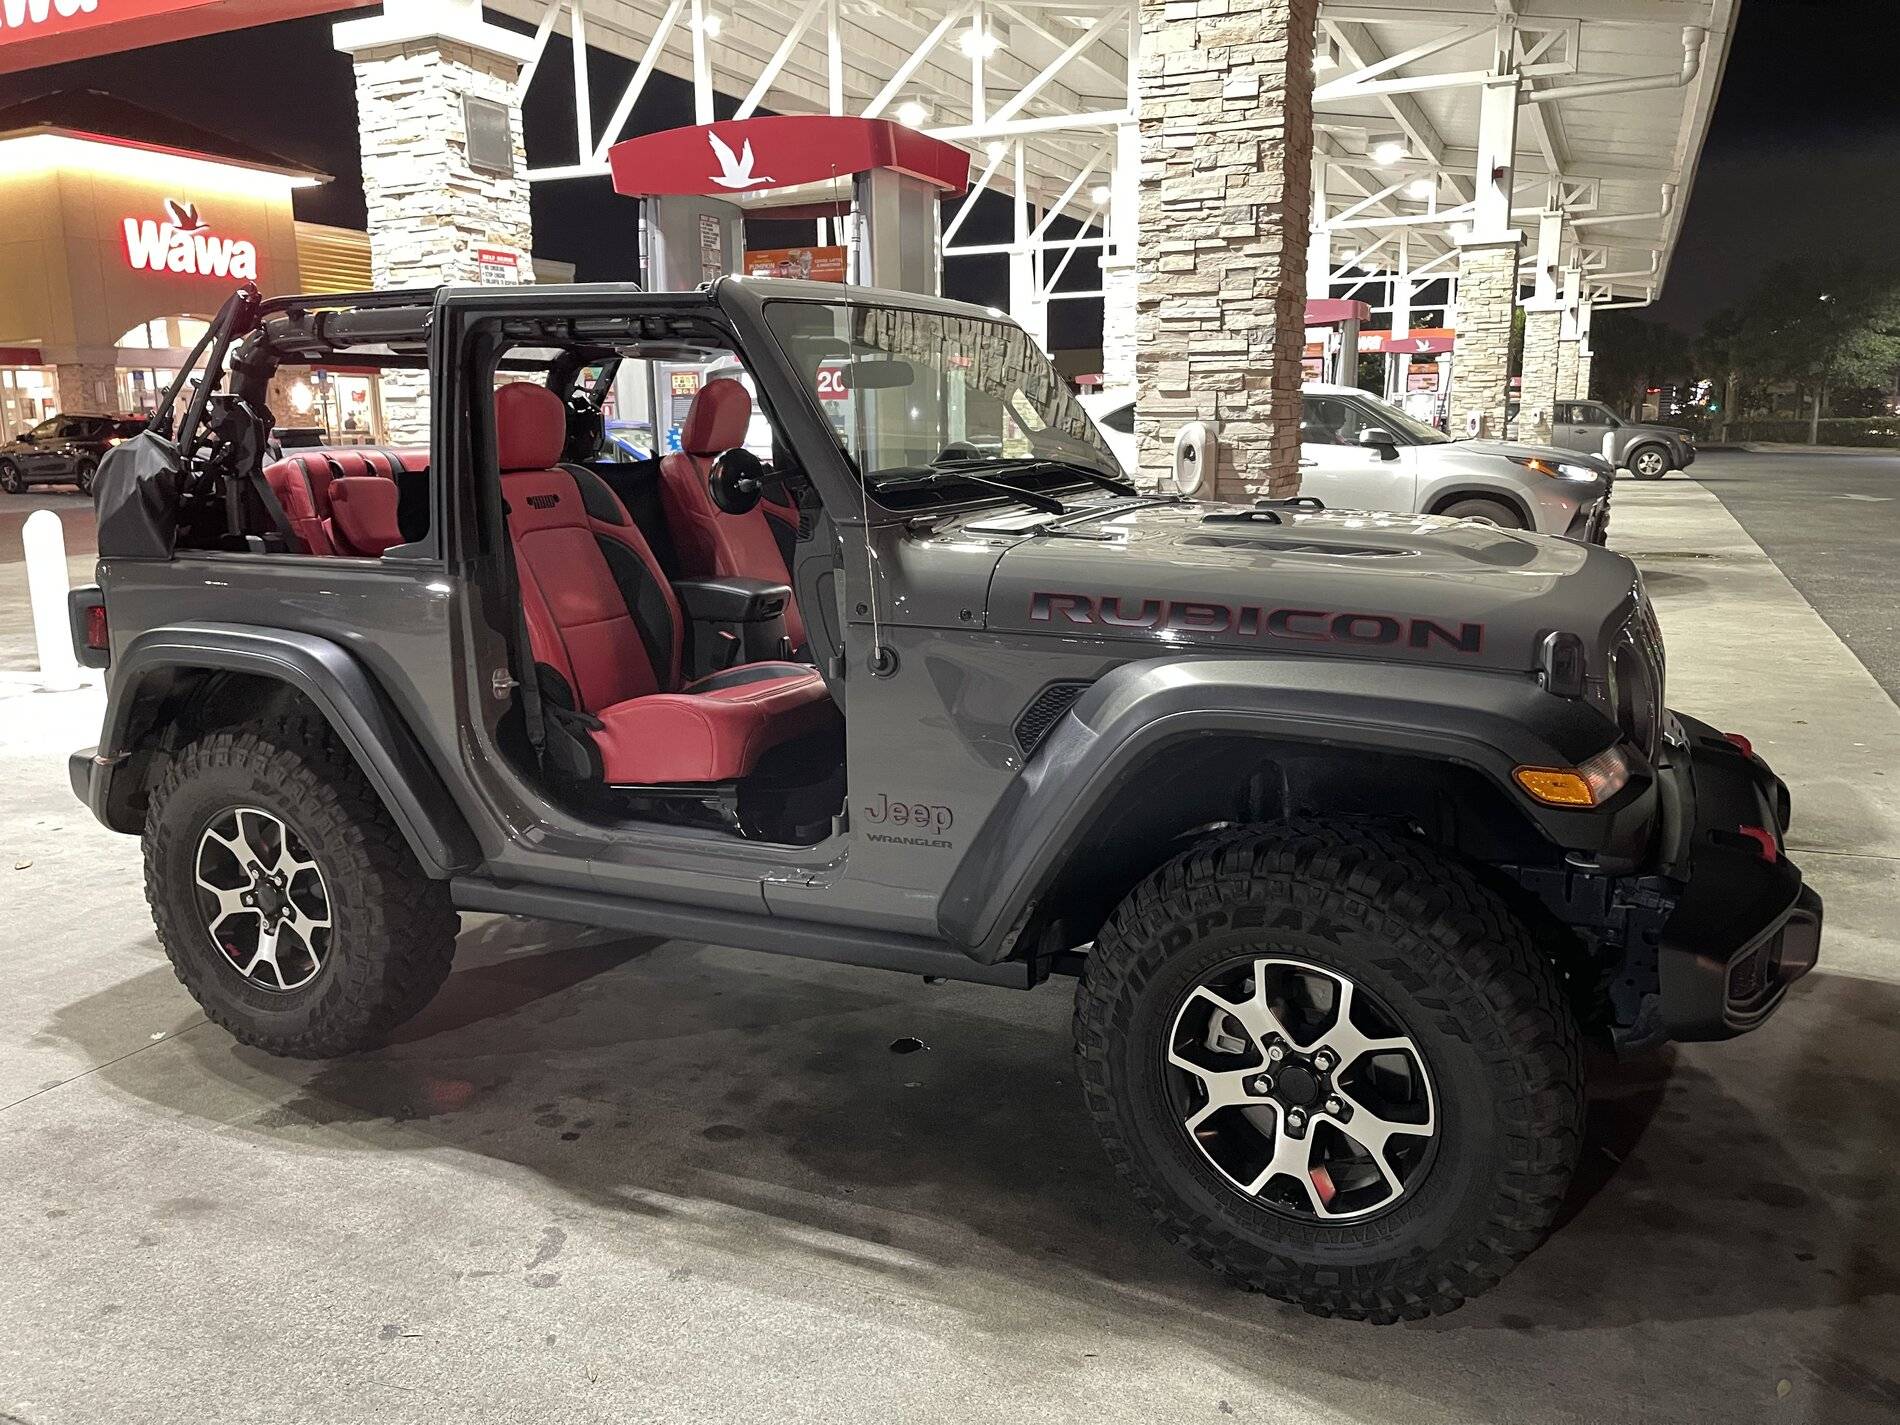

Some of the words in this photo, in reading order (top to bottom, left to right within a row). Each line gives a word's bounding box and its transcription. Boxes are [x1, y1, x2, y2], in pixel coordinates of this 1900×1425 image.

[124, 217, 257, 280] Wawa
[1029, 592, 1486, 654] RUBICON
[864, 793, 953, 835] Jeep
[866, 833, 953, 849] WRANGLER
[1111, 906, 1354, 1038] WILDPEAK
